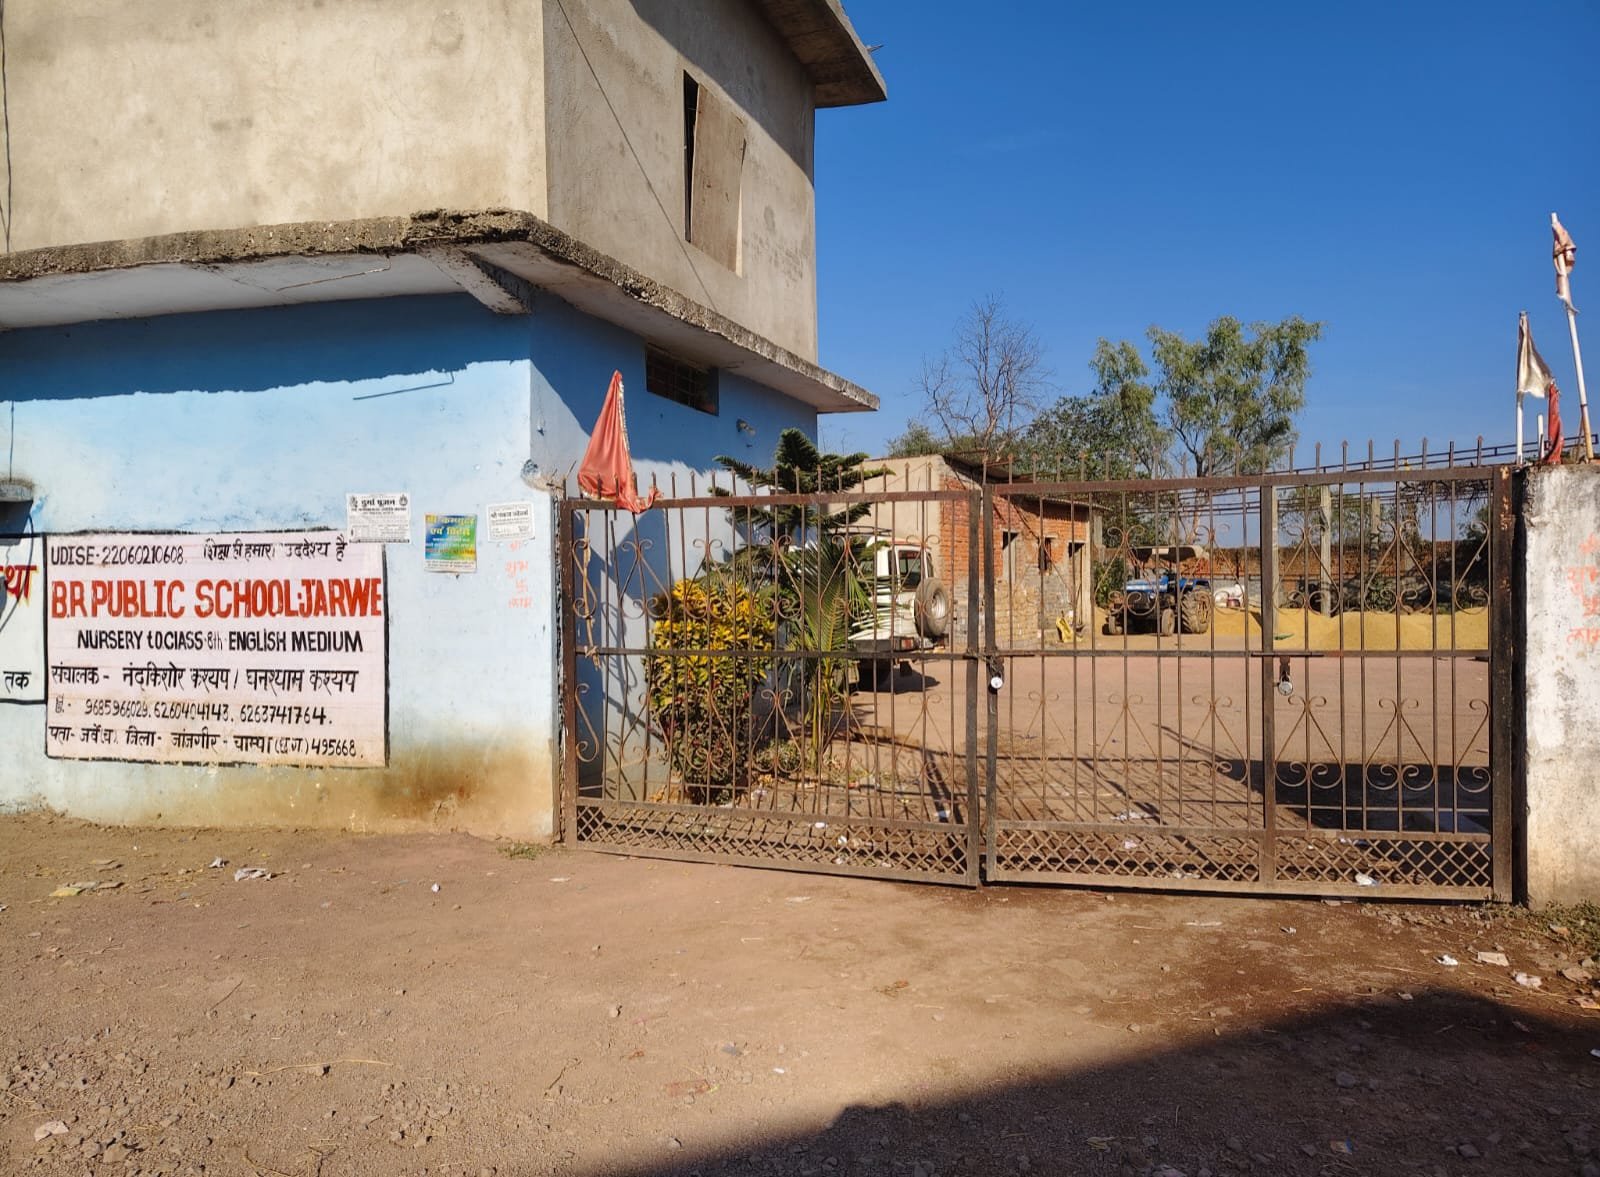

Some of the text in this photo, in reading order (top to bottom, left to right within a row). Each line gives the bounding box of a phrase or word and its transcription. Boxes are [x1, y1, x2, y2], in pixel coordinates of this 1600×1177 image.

[335, 534, 348, 562] है
[91, 579, 186, 619] PUBLIC
[77, 629, 143, 649] NURSERY
[228, 628, 287, 652] ENGLISH
[292, 630, 364, 652] MEDIUM
[3, 671, 32, 694] तक
